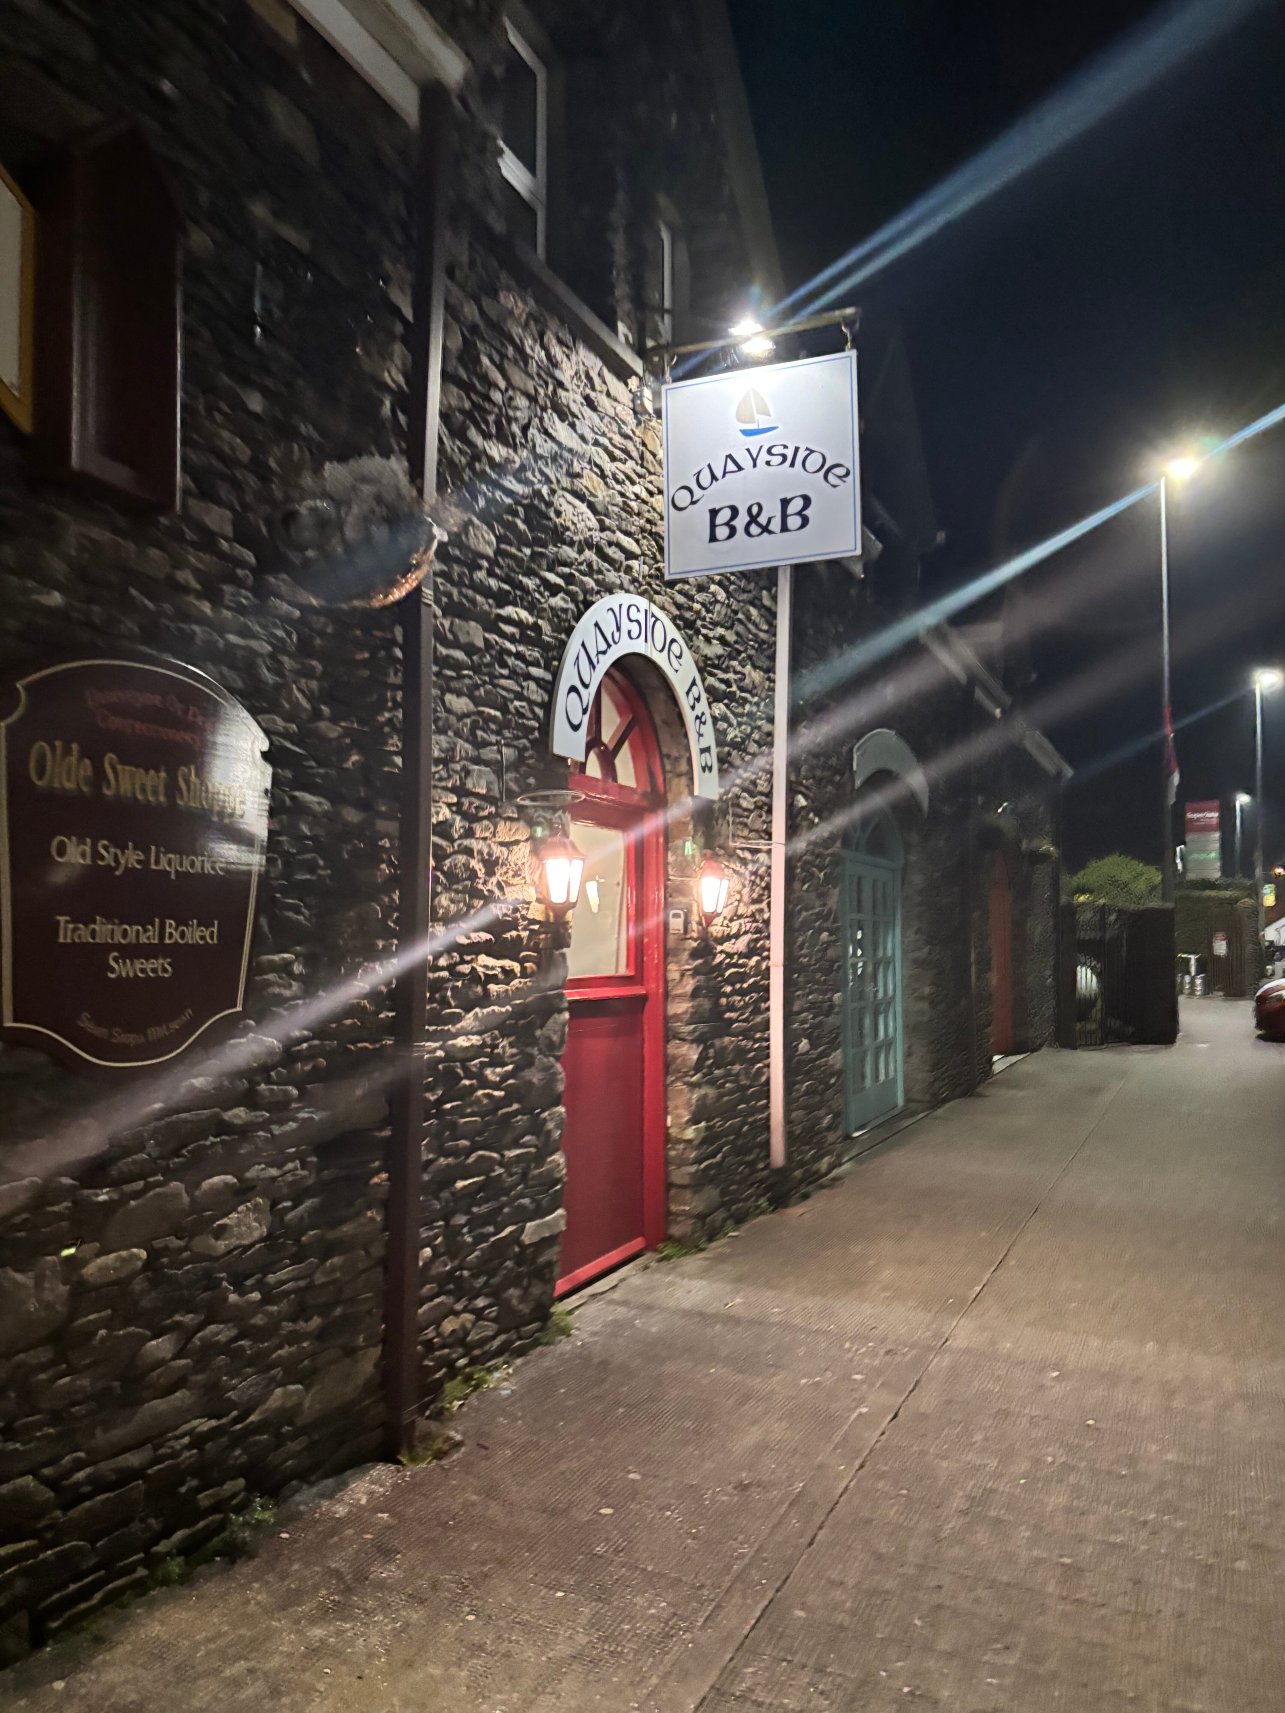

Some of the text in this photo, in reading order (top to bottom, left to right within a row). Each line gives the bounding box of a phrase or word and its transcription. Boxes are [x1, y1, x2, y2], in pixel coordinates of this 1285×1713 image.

[708, 494, 812, 543] B&B
[685, 676, 713, 774] B&B
[29, 741, 94, 792] Olde
[102, 752, 167, 802] Sweet
[50, 835, 226, 880] Old Style Liquorice
[55, 915, 218, 945] Traditional Boiled
[107, 951, 173, 979] Sweets
